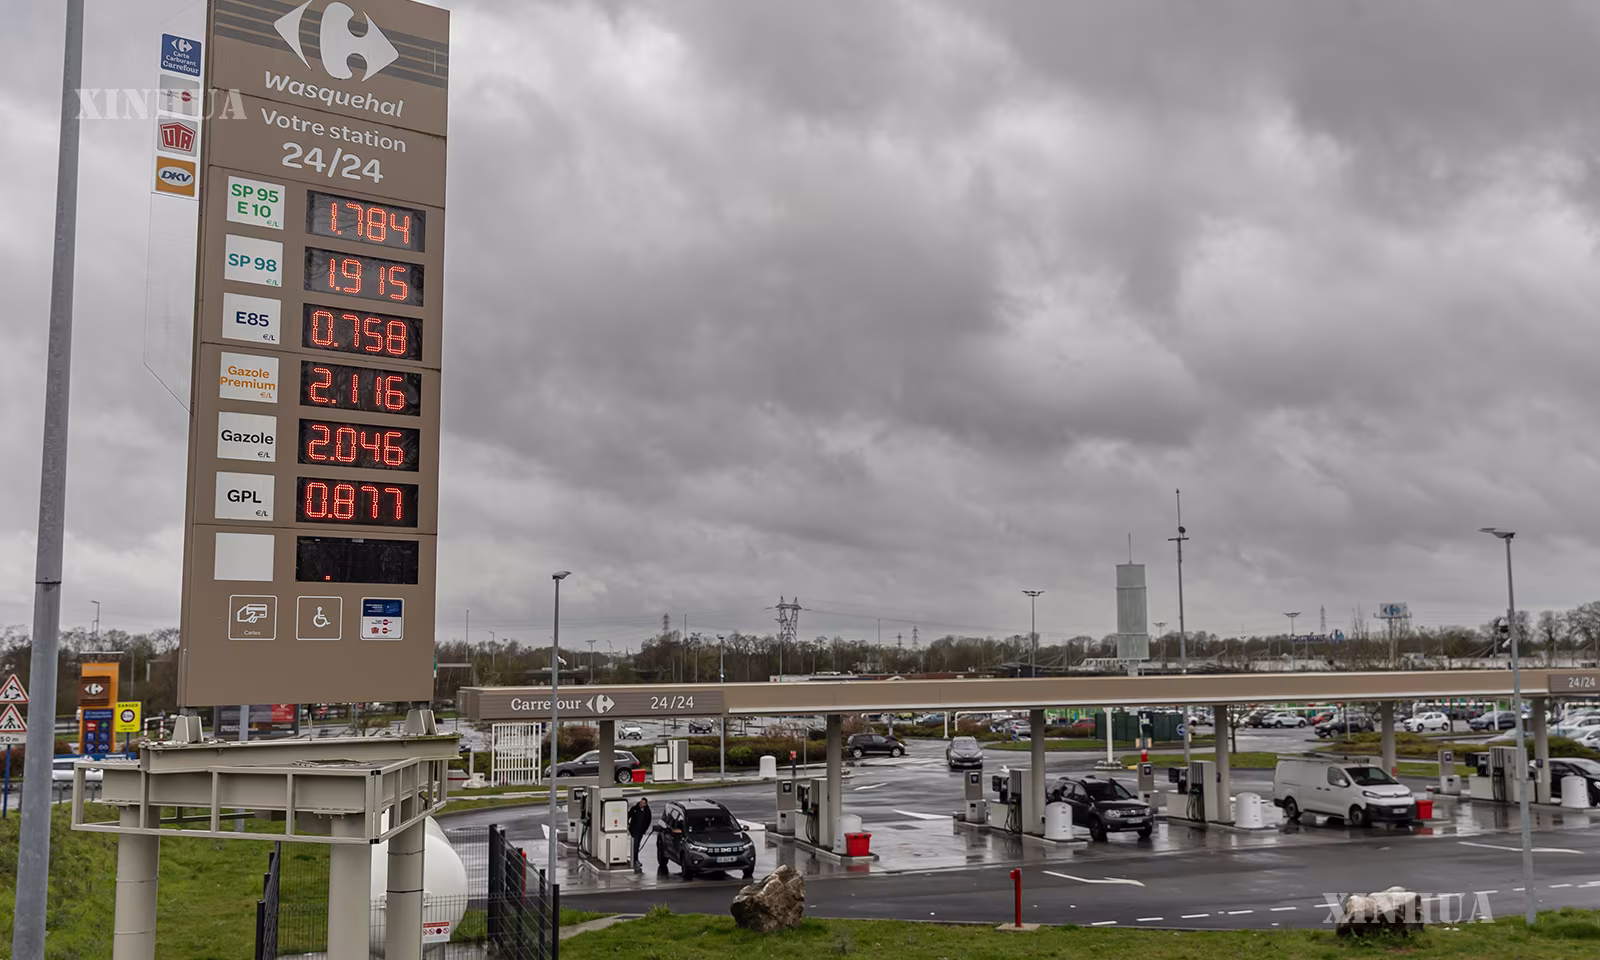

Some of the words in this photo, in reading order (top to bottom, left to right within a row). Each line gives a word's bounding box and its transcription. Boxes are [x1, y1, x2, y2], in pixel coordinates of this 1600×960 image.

[165, 54, 197, 67] Carburant
[173, 50, 190, 59] Carte
[162, 60, 199, 74] Carrefour
[265, 70, 404, 118] Wasquehal
[161, 123, 194, 151] UTA
[261, 107, 325, 136] Votre
[329, 125, 406, 153] station
[282, 142, 384, 183] 24/24
[160, 170, 191, 182] DKV
[231, 183, 254, 198] SP
[257, 188, 279, 203] 95
[237, 201, 248, 215] E
[251, 203, 272, 218] 10
[331, 202, 410, 244] 1.784
[228, 253, 251, 268] SP
[254, 258, 277, 273] 98
[329, 258, 408, 301] 1.915
[235, 311, 270, 327] E85
[312, 310, 407, 355] 0.758
[227, 365, 270, 379] Gazole
[220, 376, 276, 391] Premium
[310, 367, 405, 411] 2.116
[221, 429, 274, 445] Gazole
[308, 424, 404, 466] 2.046
[227, 489, 262, 504] GPL
[306, 482, 402, 520] 0.877
[1568, 676, 1596, 688] 24/24
[511, 697, 582, 711] Carreour
[650, 696, 695, 709] 24/24
